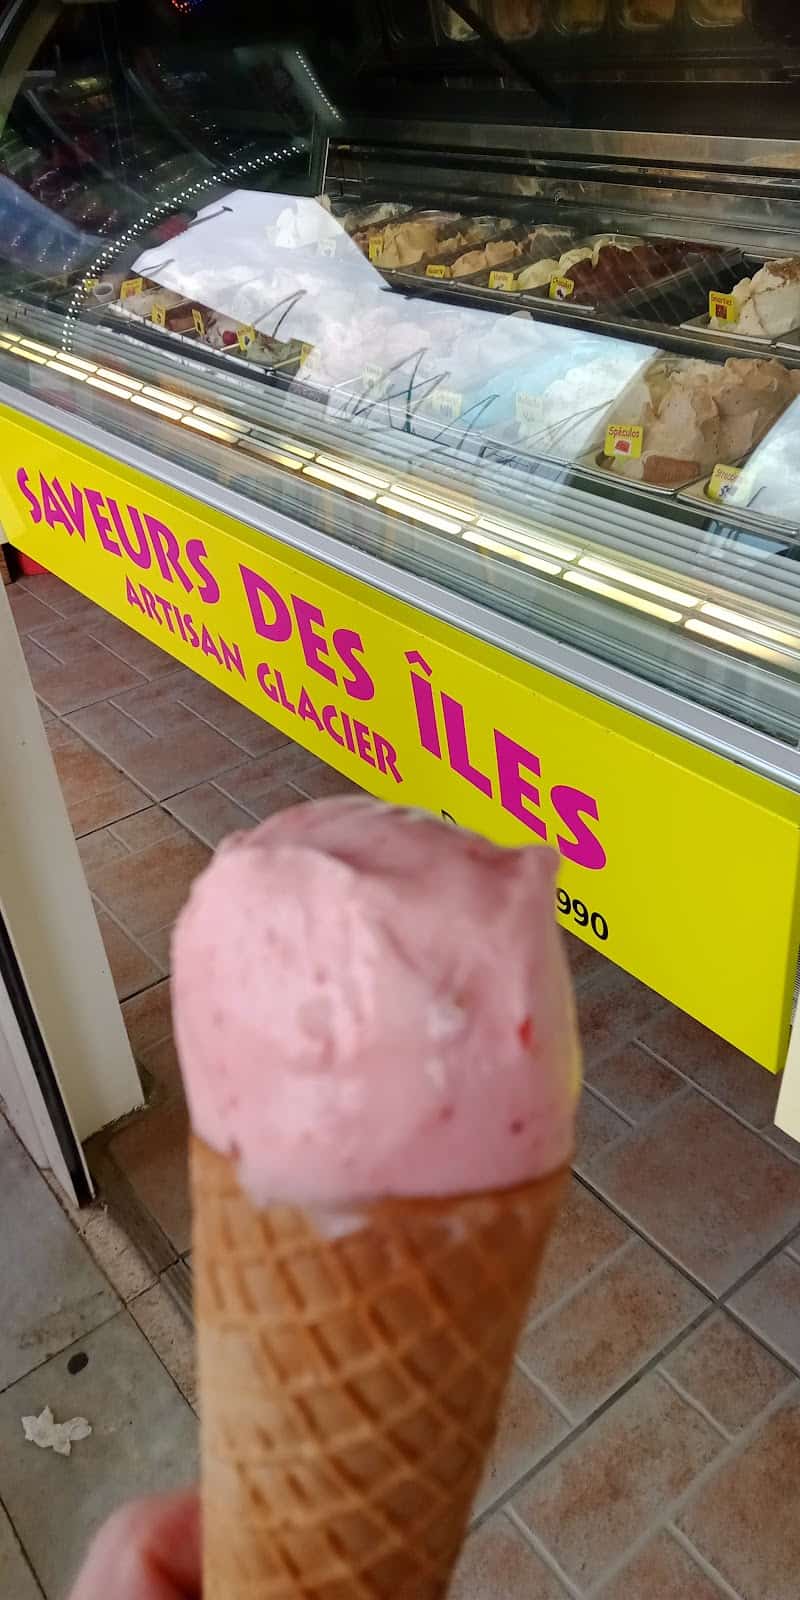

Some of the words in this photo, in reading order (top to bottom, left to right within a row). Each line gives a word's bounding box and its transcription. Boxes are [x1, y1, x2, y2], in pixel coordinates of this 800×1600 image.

[17, 466, 220, 604] SAVEURS
[240, 564, 375, 701] DES
[404, 650, 607, 870] ÎLES
[125, 574, 247, 681] ARTISAN
[256, 662, 403, 784] GLACIER
[556, 887, 609, 941] 990
